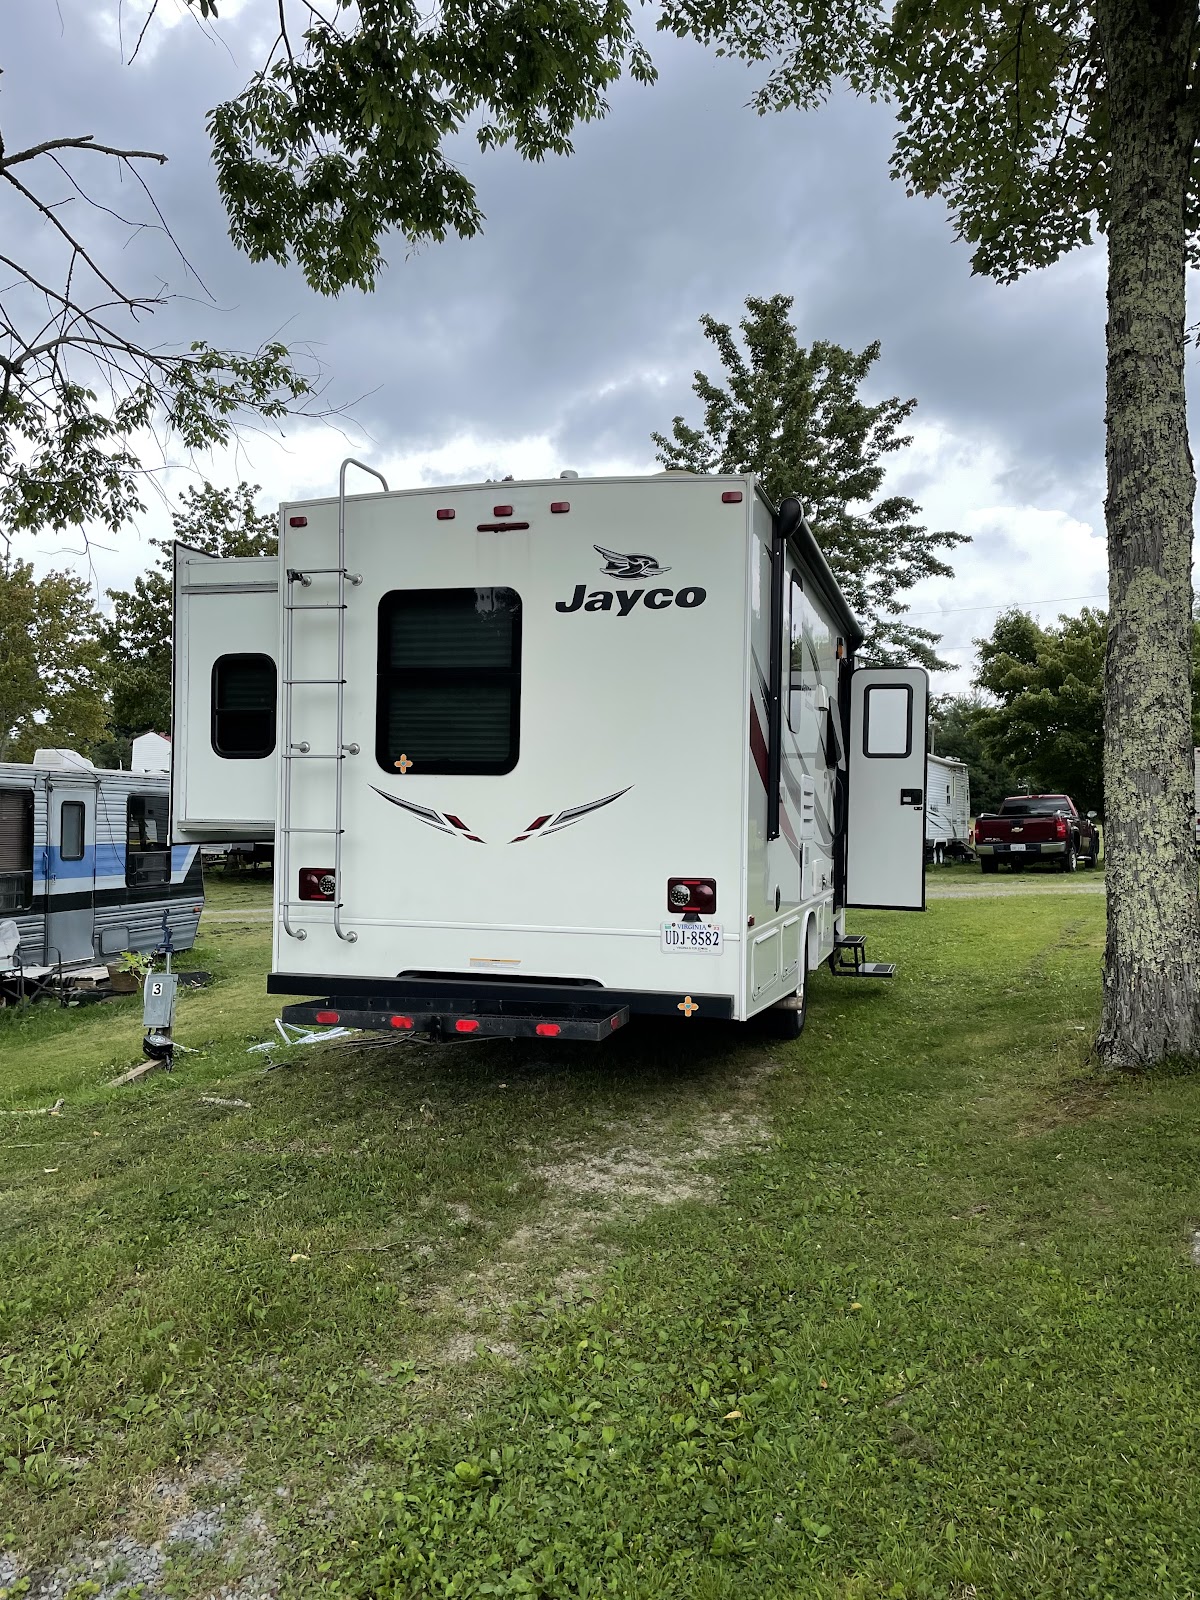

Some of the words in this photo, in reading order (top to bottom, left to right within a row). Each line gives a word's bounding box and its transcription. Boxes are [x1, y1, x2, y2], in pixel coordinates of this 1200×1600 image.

[555, 584, 707, 617] Jayco
[665, 931, 720, 946] UDJ-8582
[153, 983, 162, 995] 3
